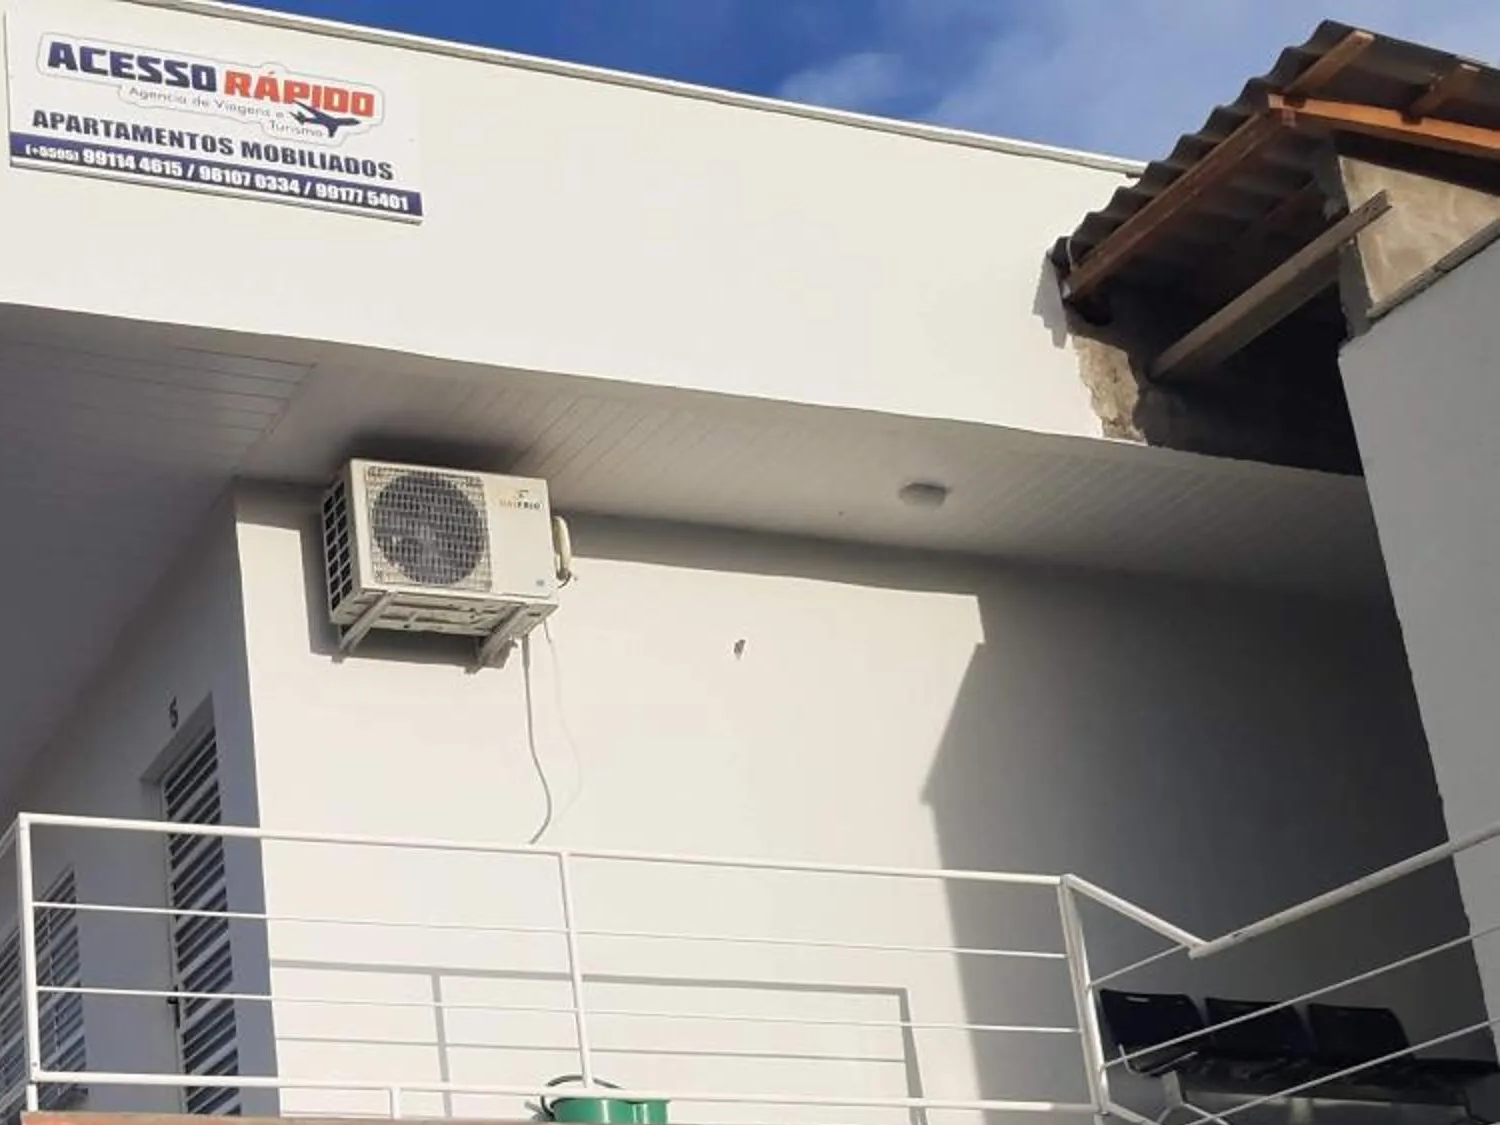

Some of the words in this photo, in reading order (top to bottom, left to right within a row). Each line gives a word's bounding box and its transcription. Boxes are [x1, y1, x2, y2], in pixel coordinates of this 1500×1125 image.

[47, 41, 217, 92] ACESSO
[224, 70, 375, 118] RÁPIDO
[192, 96, 209, 107] de
[214, 99, 270, 118] Viagens
[32, 109, 234, 155] APARTAMENTOS
[240, 140, 394, 180] MOBILIADOS
[269, 119, 323, 137] Turismo
[82, 148, 135, 171] 99114
[139, 157, 182, 177] 4615
[315, 182, 363, 203] 99177
